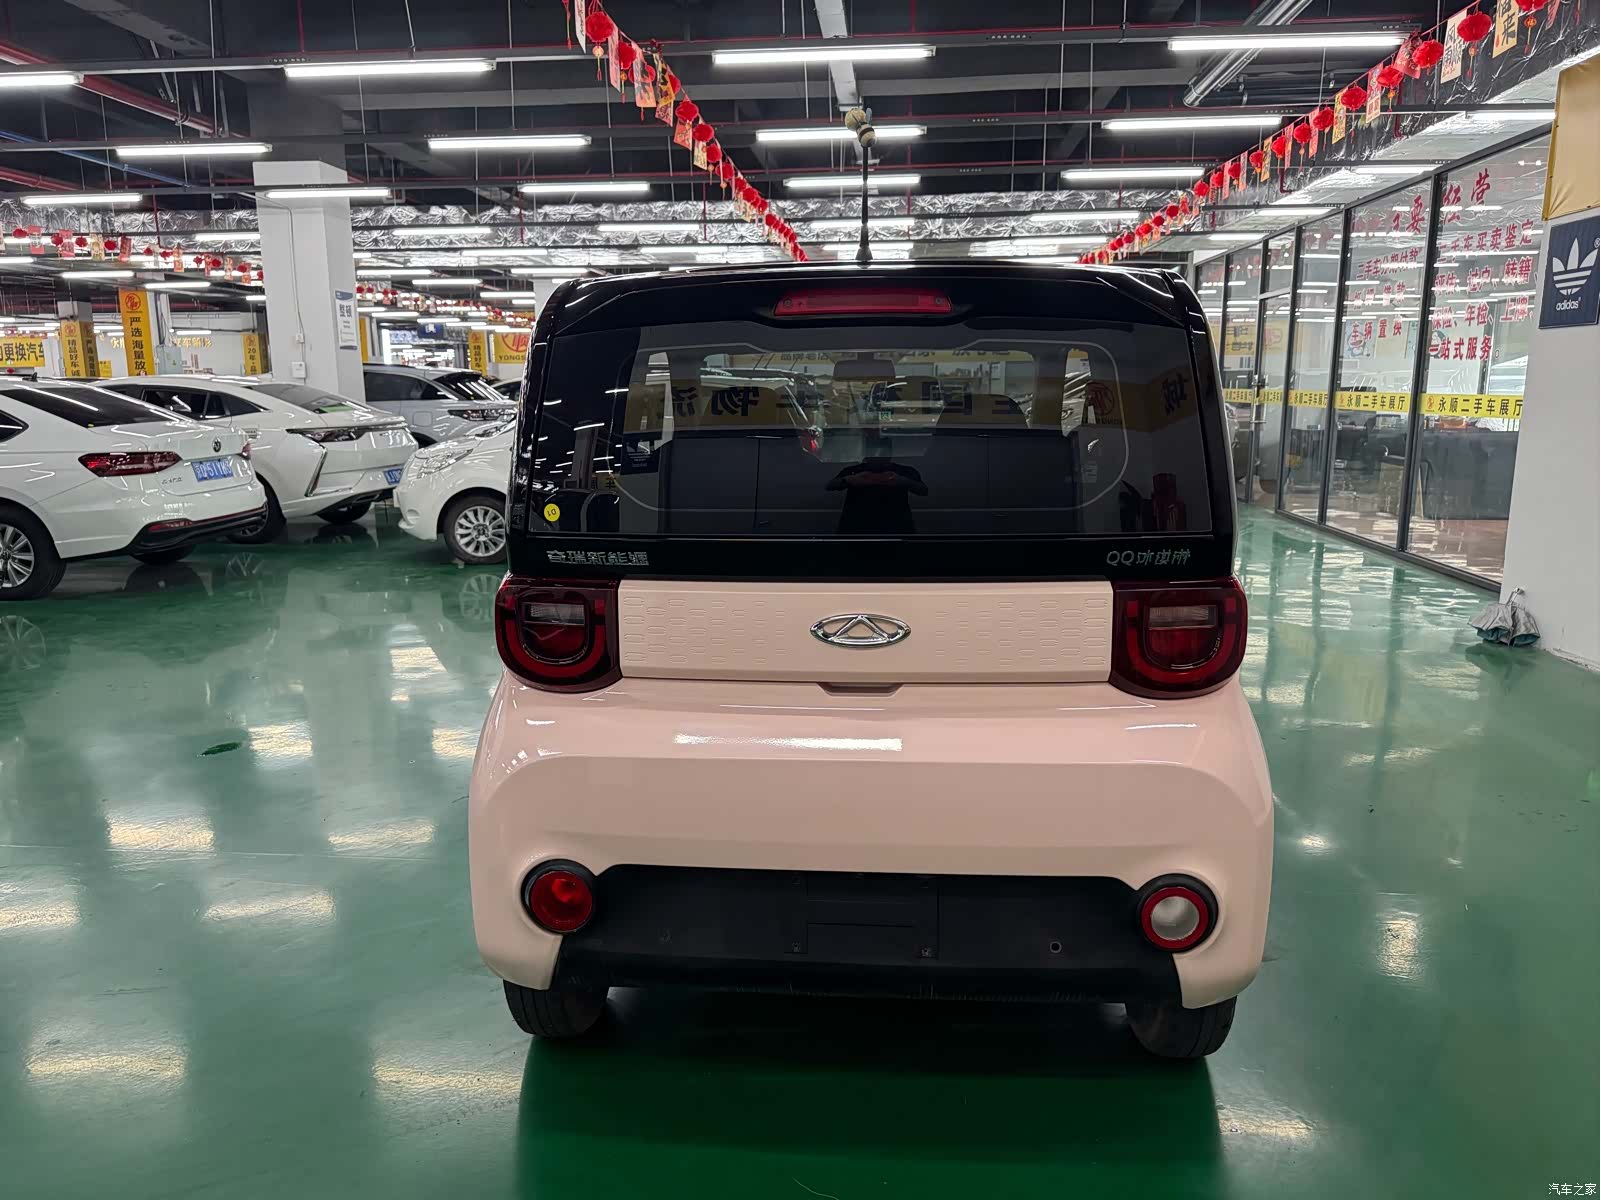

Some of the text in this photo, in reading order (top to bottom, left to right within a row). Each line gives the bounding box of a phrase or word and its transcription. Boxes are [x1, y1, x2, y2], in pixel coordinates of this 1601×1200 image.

[1556, 299, 1579, 311] adidas
[1347, 395, 1406, 410] 永顺二手车展厅
[1437, 396, 1524, 416] 永顺二手车展厅
[546, 550, 650, 566] 奇瑞新能源
[1106, 548, 1191, 566] QQ冰淇淋
